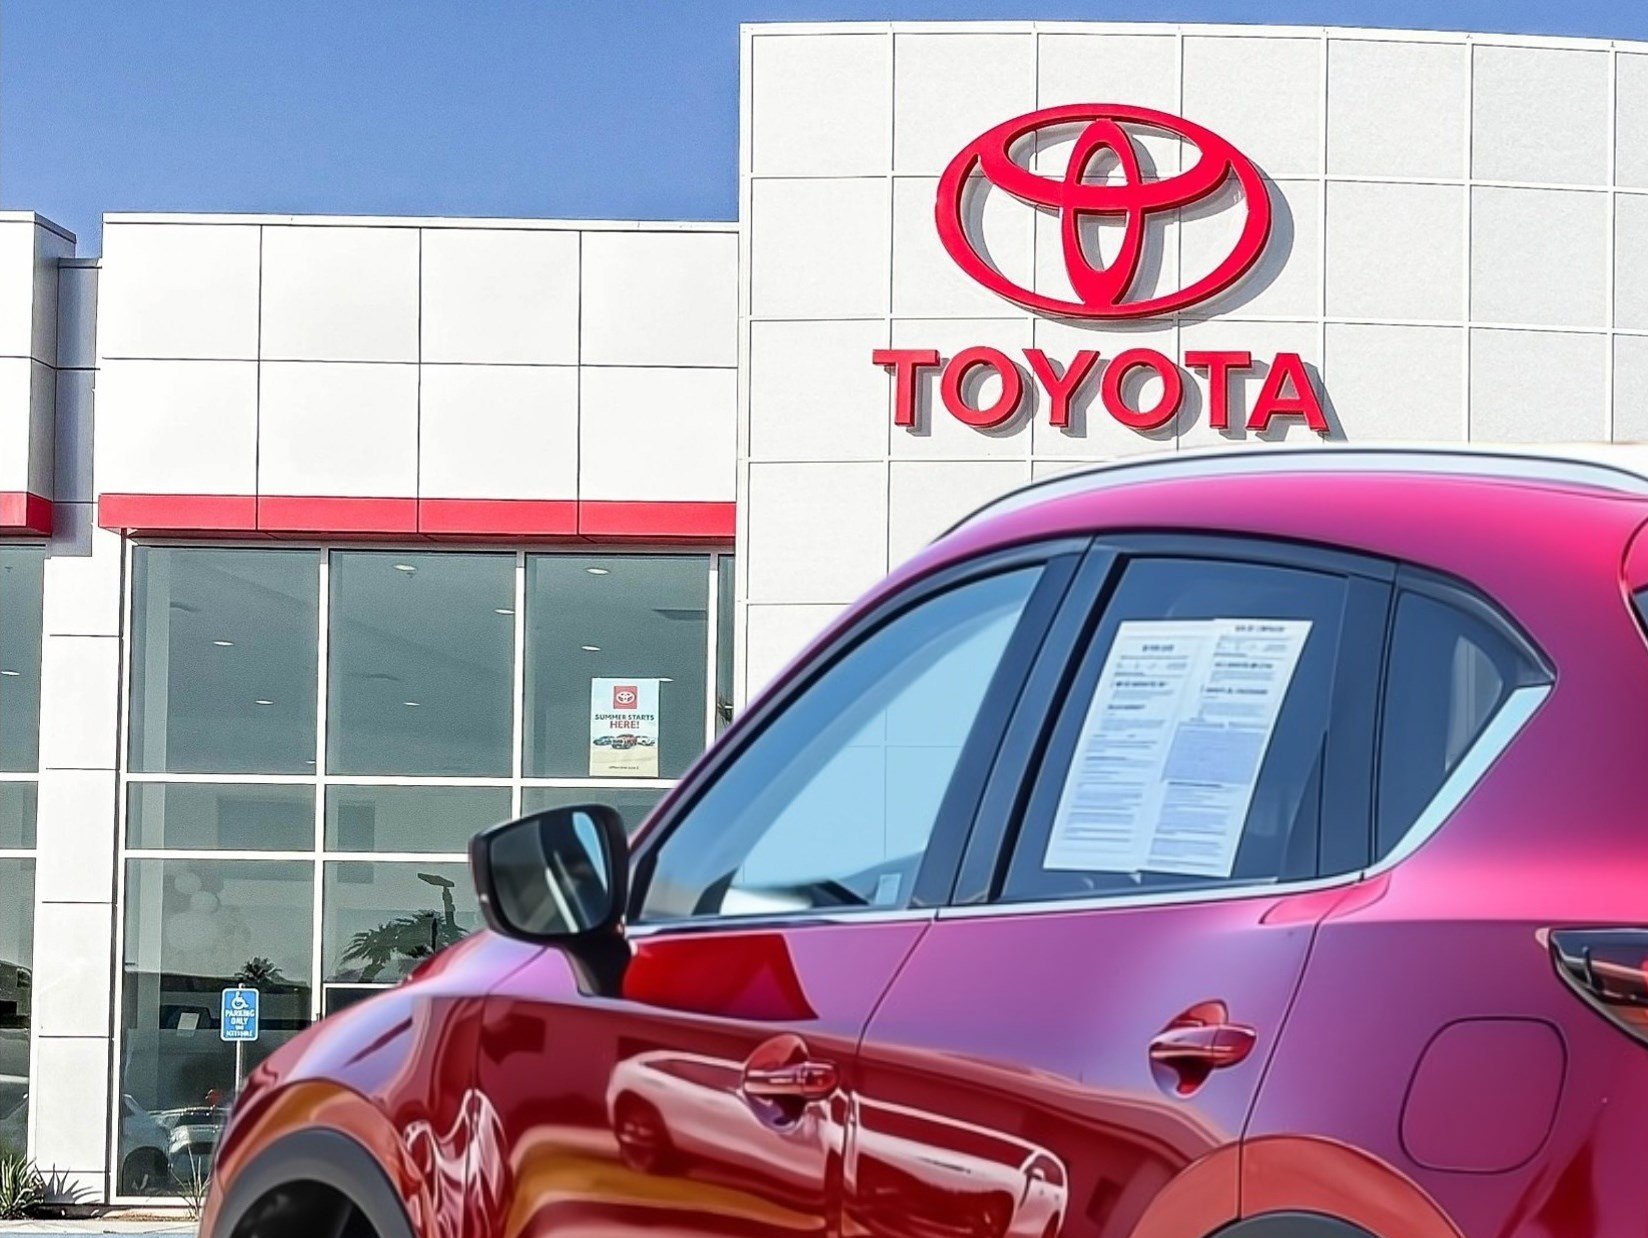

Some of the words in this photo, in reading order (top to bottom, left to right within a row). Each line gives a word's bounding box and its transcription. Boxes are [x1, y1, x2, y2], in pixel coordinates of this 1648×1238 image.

[873, 346, 1330, 431] TOYOTA
[610, 721, 640, 729] HERE!
[225, 1009, 255, 1017] PARKING
